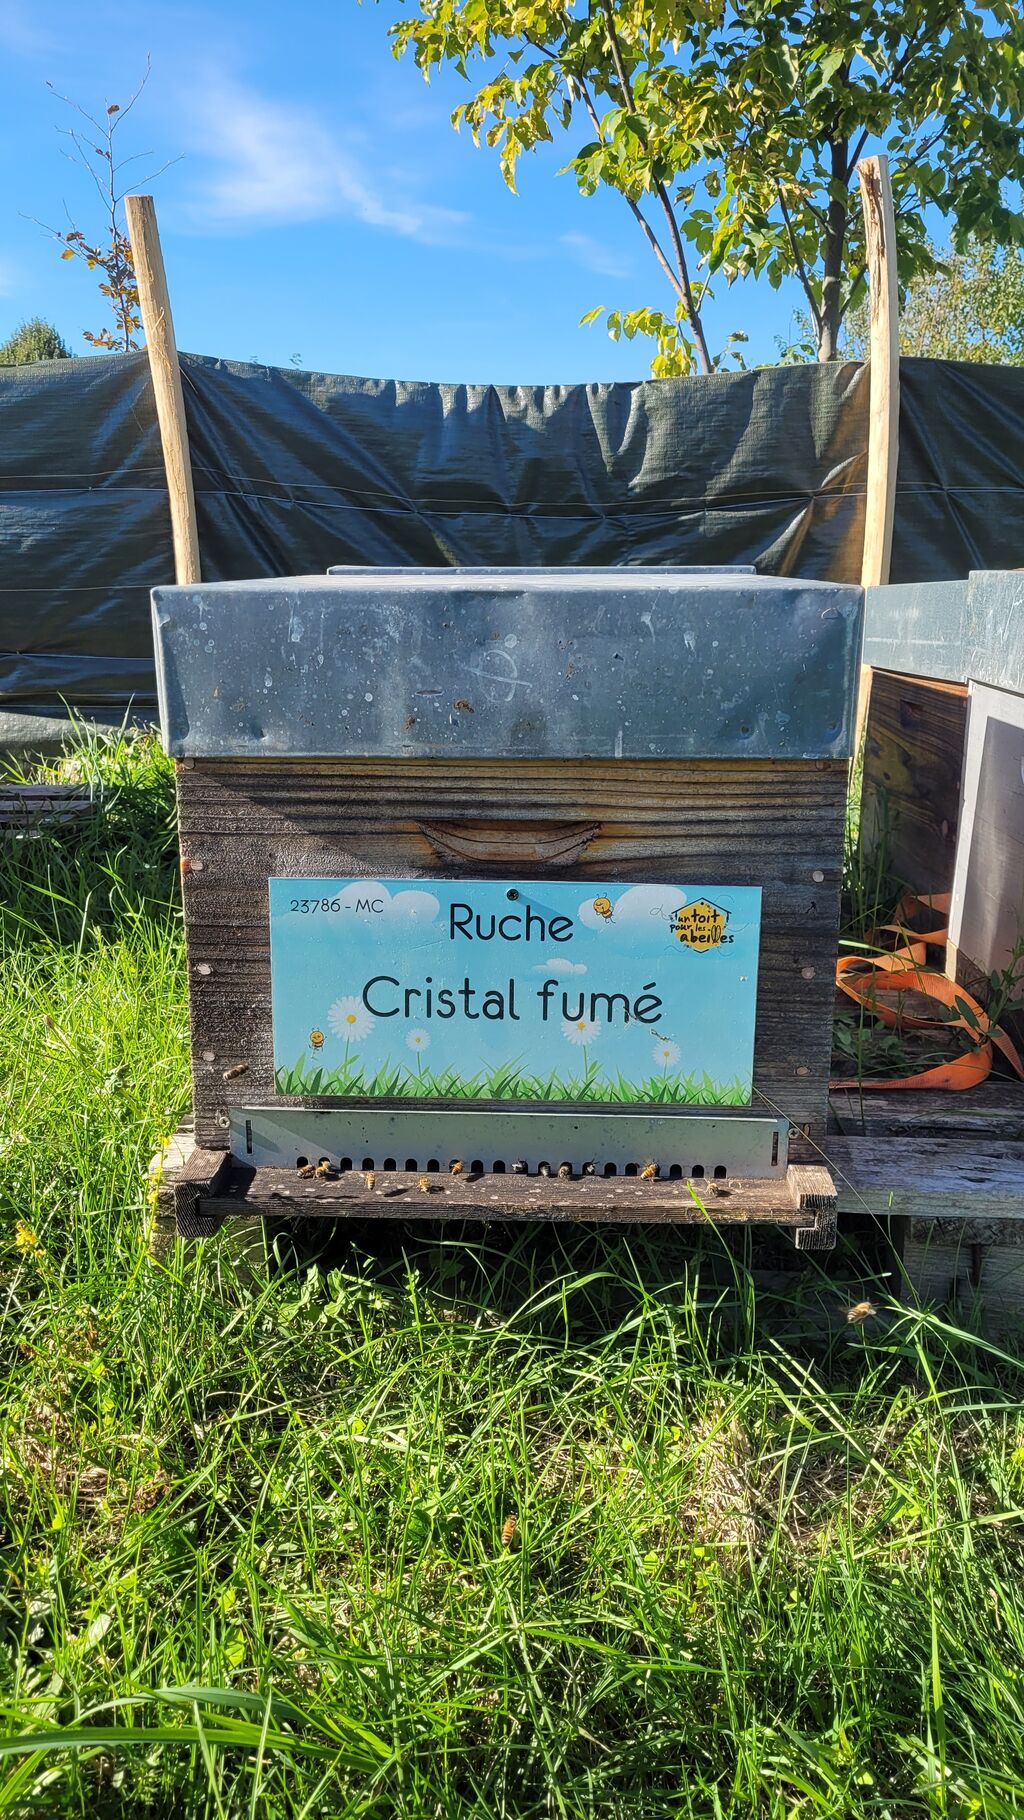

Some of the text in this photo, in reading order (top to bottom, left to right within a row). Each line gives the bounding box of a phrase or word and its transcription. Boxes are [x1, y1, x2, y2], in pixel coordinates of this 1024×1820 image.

[289, 898, 341, 914] 23786
[355, 898, 384, 914] MC
[449, 903, 574, 942] Ruche
[690, 908, 721, 924] toit
[669, 923, 707, 934] pour les
[679, 924, 735, 945] abeilles
[362, 975, 663, 1024] Cristal fumé
